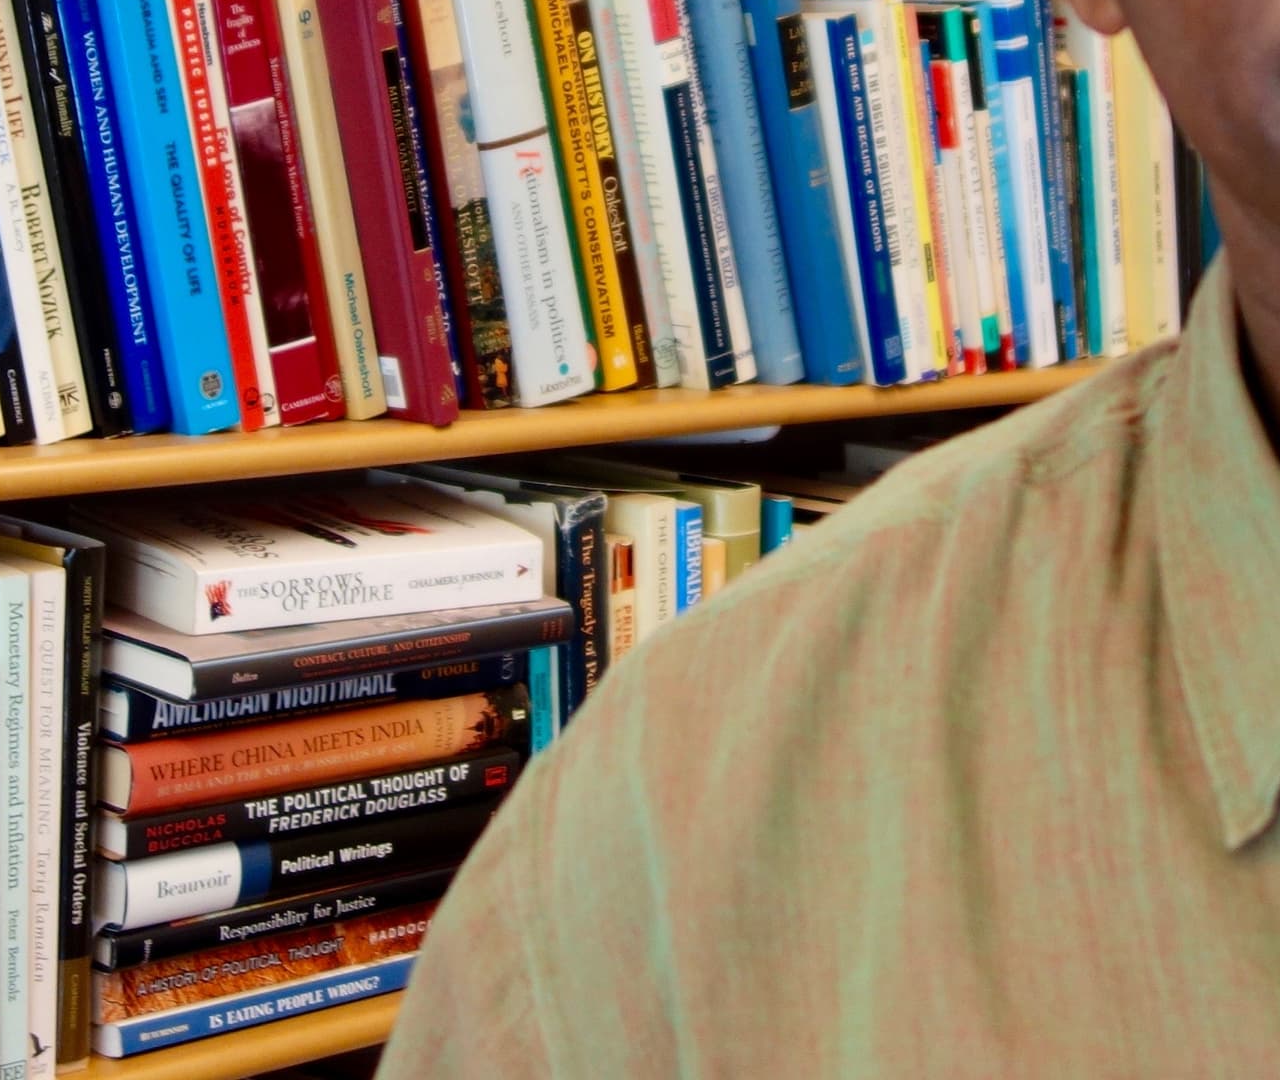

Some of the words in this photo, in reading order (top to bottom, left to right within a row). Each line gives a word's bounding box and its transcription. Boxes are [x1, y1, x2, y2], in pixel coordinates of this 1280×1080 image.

[83, 30, 106, 102] WOMEN
[94, 104, 112, 145] AND
[102, 147, 126, 217] HUMAN
[561, 80, 592, 205] OAKESHOTT'S
[582, 206, 616, 340] CONSERVATISM
[114, 221, 148, 345] DEVELOPMENT
[344, 272, 362, 327] Michael
[352, 329, 373, 400] Oakeshott
[238, 586, 260, 600] THE
[259, 572, 365, 600] SORROWS
[281, 592, 313, 613] OF
[318, 583, 395, 609] EMPIRE
[8, 601, 24, 690] Monetary
[8, 694, 24, 770] Regimes
[75, 721, 92, 786] Violence
[149, 753, 225, 782] WHERE
[231, 741, 295, 769] CHINA
[302, 727, 364, 757] MEETS
[371, 716, 426, 747] INDIA
[8, 774, 24, 806] and
[74, 790, 89, 819] and
[244, 797, 279, 821] THE
[283, 784, 367, 816] POLITICAL
[369, 773, 445, 804] THOUGHT
[448, 764, 471, 784] OF
[268, 802, 360, 835] FREDERICK
[364, 786, 448, 816] DOUGLASS
[8, 809, 25, 890] Inflation
[73, 821, 89, 869] Social
[280, 851, 335, 875] Political
[339, 839, 394, 868] Writings
[71, 872, 88, 926] Orders
[156, 869, 233, 900] Beauvoir
[219, 909, 309, 943] Responsibility
[313, 902, 333, 920] for
[335, 892, 378, 919] Justice
[208, 1011, 222, 1031] IS
[225, 1001, 274, 1027] EATING
[276, 987, 325, 1016] PEOPLE
[327, 975, 381, 1002] WRONG?
